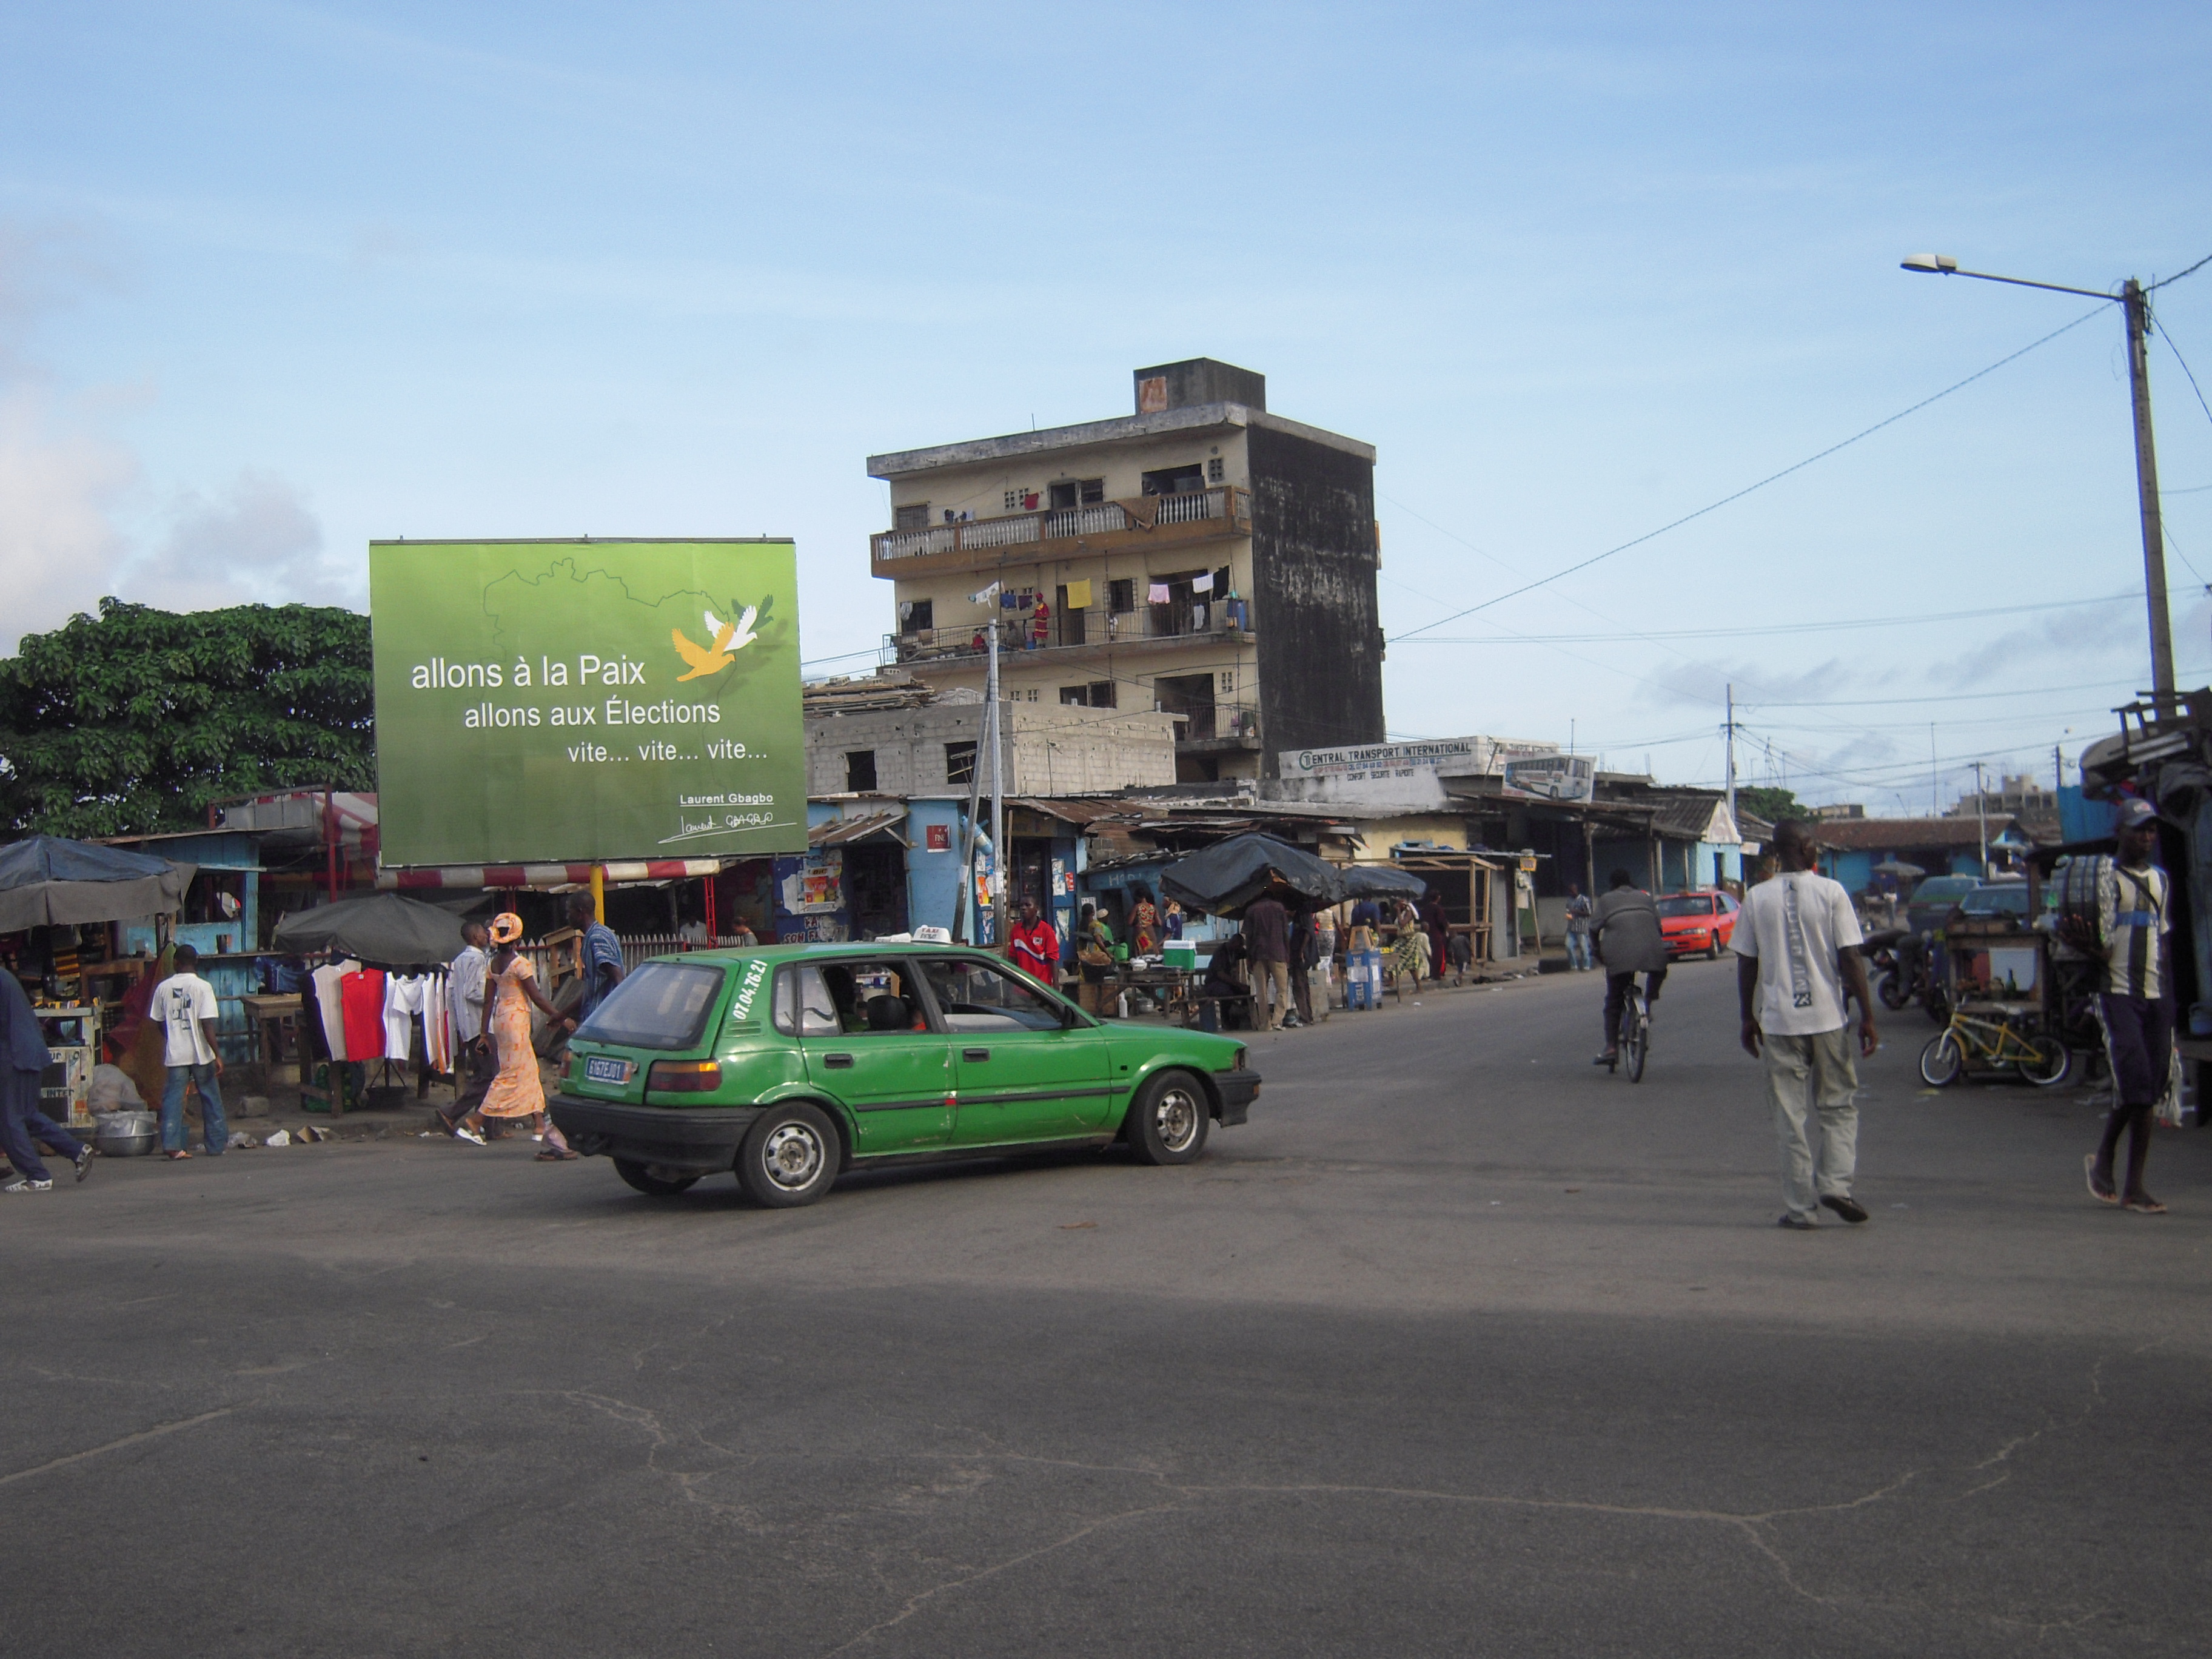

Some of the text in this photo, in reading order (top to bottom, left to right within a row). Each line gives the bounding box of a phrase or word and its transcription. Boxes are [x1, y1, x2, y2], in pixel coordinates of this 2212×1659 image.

[412, 654, 646, 689] allons à la Paix
[464, 694, 721, 728] allons aux Élections
[568, 738, 768, 762] vite... vite... vite...
[1348, 747, 1399, 760] TRANSPORT
[1403, 742, 1471, 756] INTERNATIONAL
[680, 793, 773, 805] Laurent Gbagbo
[784, 931, 805, 943] SON
[732, 959, 768, 1020] 07.04.76.21
[1794, 992, 1812, 1008] 23
